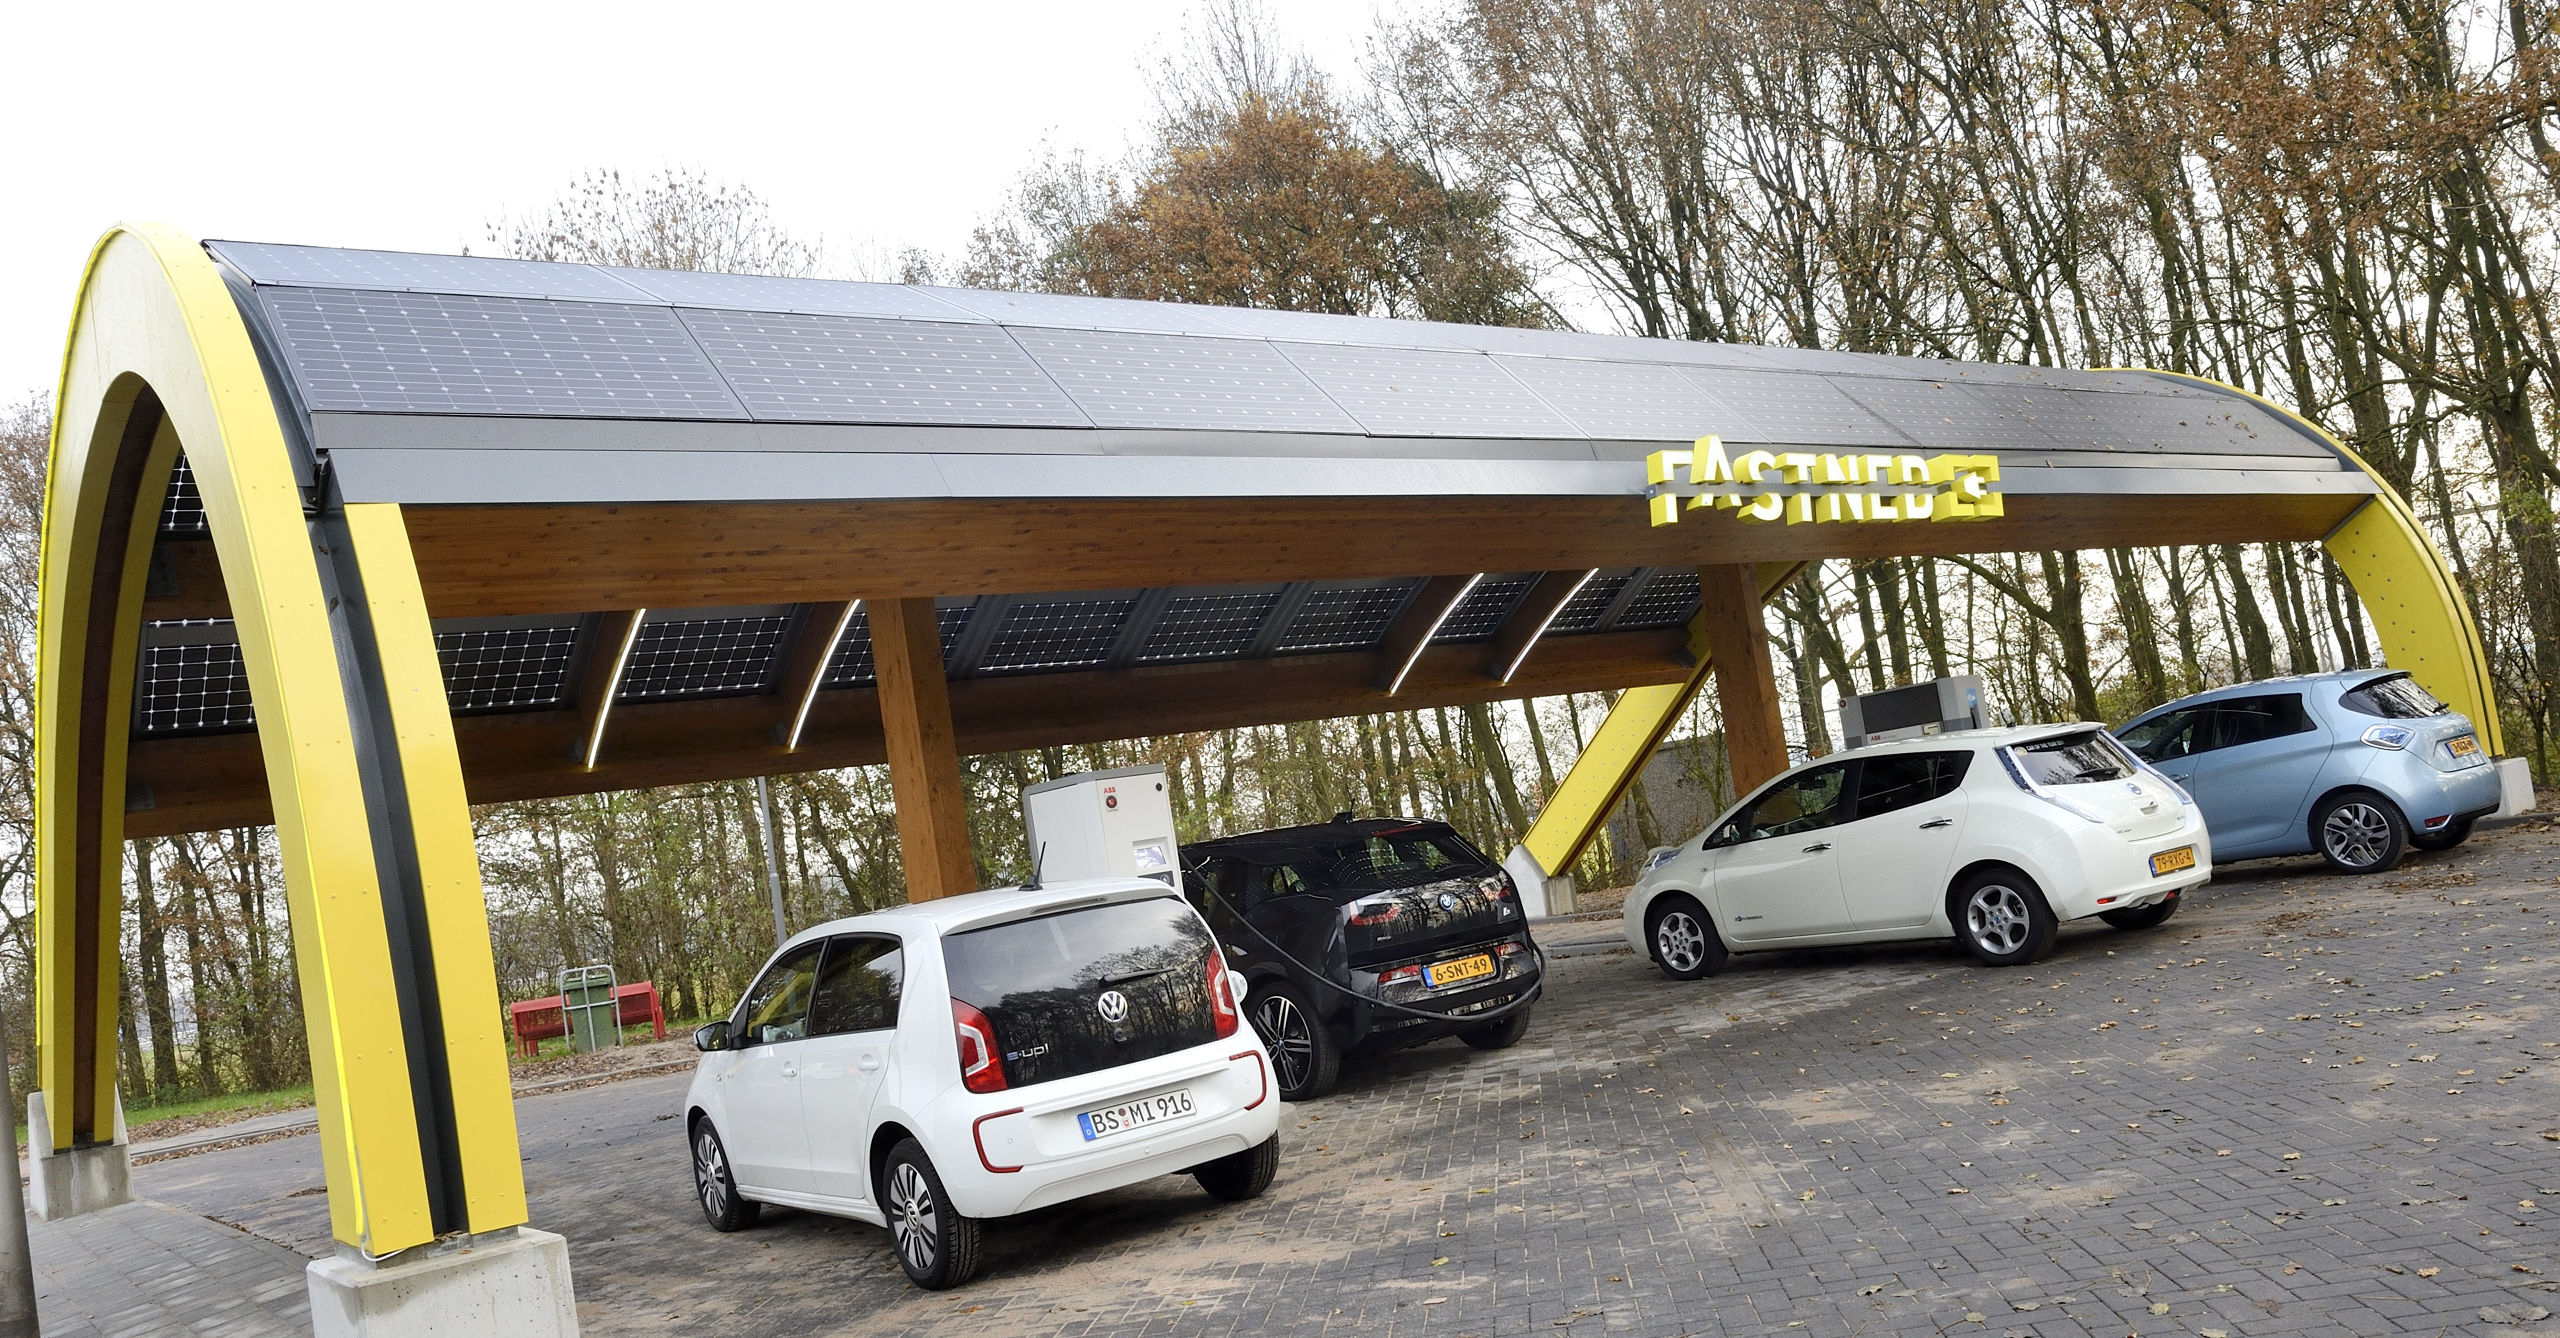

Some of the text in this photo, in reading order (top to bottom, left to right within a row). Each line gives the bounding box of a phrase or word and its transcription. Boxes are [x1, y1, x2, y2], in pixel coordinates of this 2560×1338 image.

[1646, 434, 1933, 527] FASTNED
[2156, 852, 2192, 870] 79-RXG-4
[1436, 958, 1487, 981] 6-SNT-49
[1091, 1092, 1192, 1134] BS MI 916
